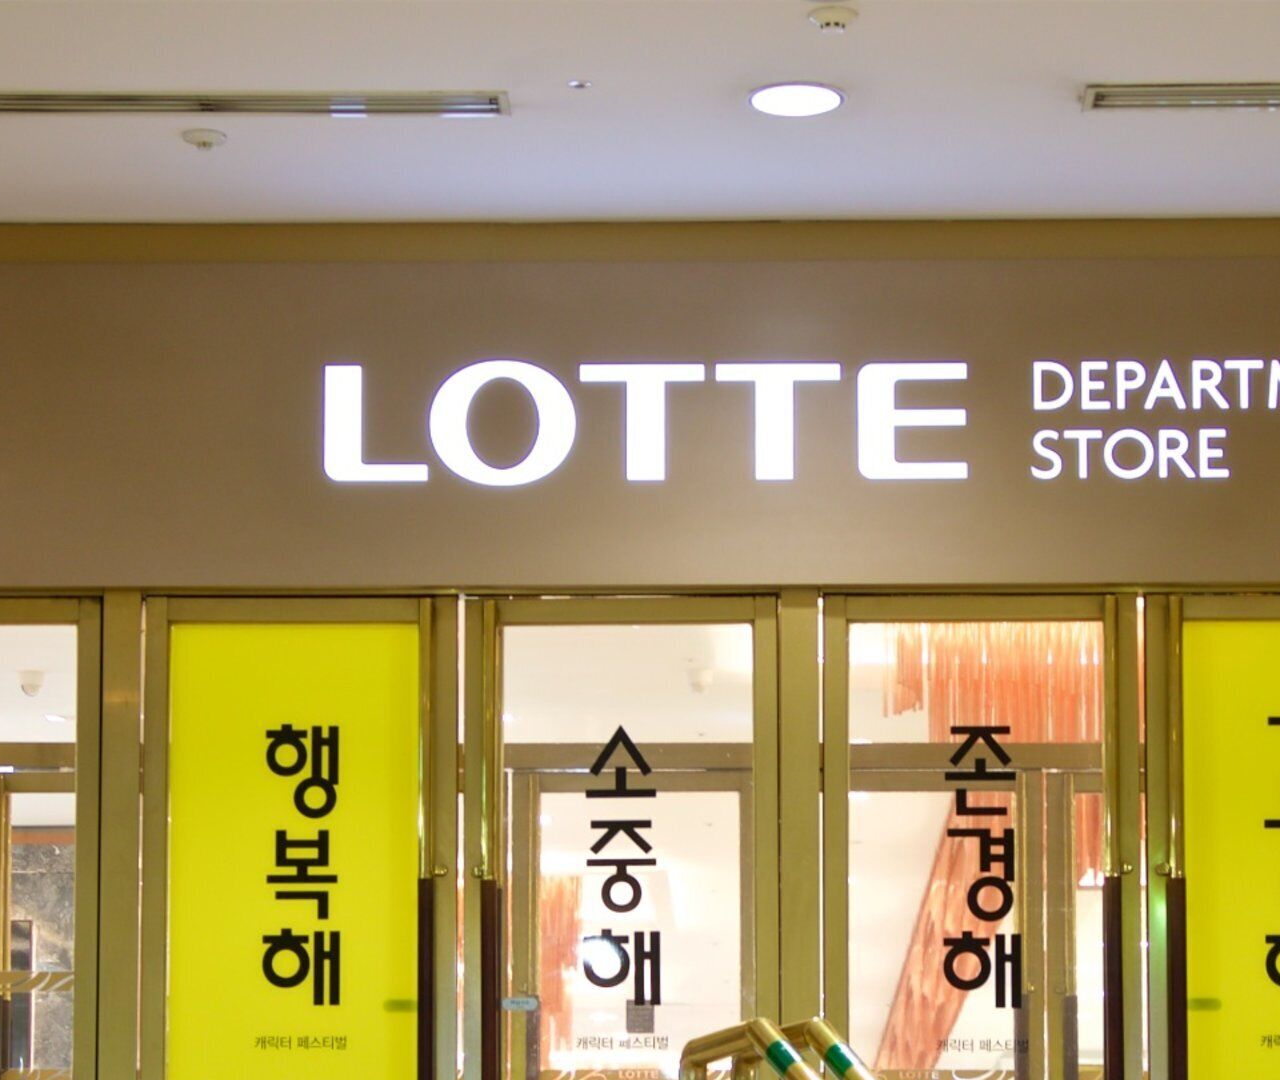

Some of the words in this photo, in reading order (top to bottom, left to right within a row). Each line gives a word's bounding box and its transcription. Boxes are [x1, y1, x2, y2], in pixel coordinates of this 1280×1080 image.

[323, 359, 969, 488] LOTTE
[1029, 427, 1231, 481] STORE
[262, 723, 341, 1006] 행복해
[584, 725, 662, 1007] 소중해
[943, 725, 1023, 1009] 존경해
[254, 1035, 292, 1051] 캐릭터
[296, 1035, 347, 1051] 페스티벌
[576, 1035, 614, 1051] 캐릭터
[618, 1035, 669, 1051] 페스티벌
[618, 1069, 660, 1080] LOTTE
